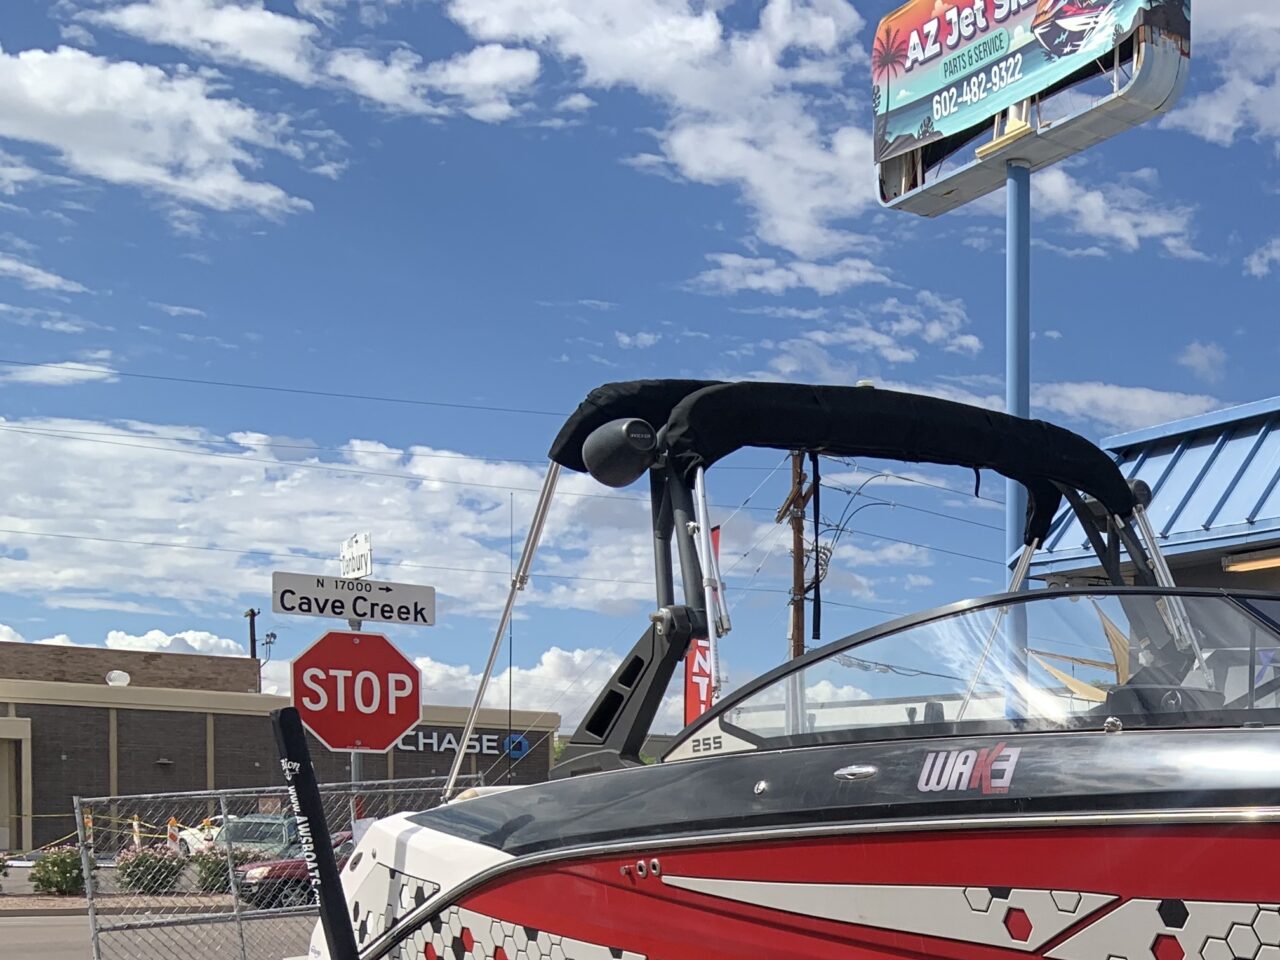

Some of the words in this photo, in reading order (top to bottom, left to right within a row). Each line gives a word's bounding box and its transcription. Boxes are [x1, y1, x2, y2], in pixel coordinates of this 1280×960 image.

[905, 17, 942, 71] AZ
[946, 0, 988, 48] Jet
[943, 53, 967, 79] PARTS
[968, 50, 977, 67] &
[974, 32, 1005, 64] SERVICE
[932, 53, 1023, 120] 602-482-9322
[316, 578, 325, 588] N
[335, 580, 372, 592] 17000
[280, 589, 345, 616] Cave
[352, 596, 428, 623] Creek
[302, 667, 413, 714] STOP
[397, 731, 500, 754] CHASE
[692, 735, 722, 752] 255
